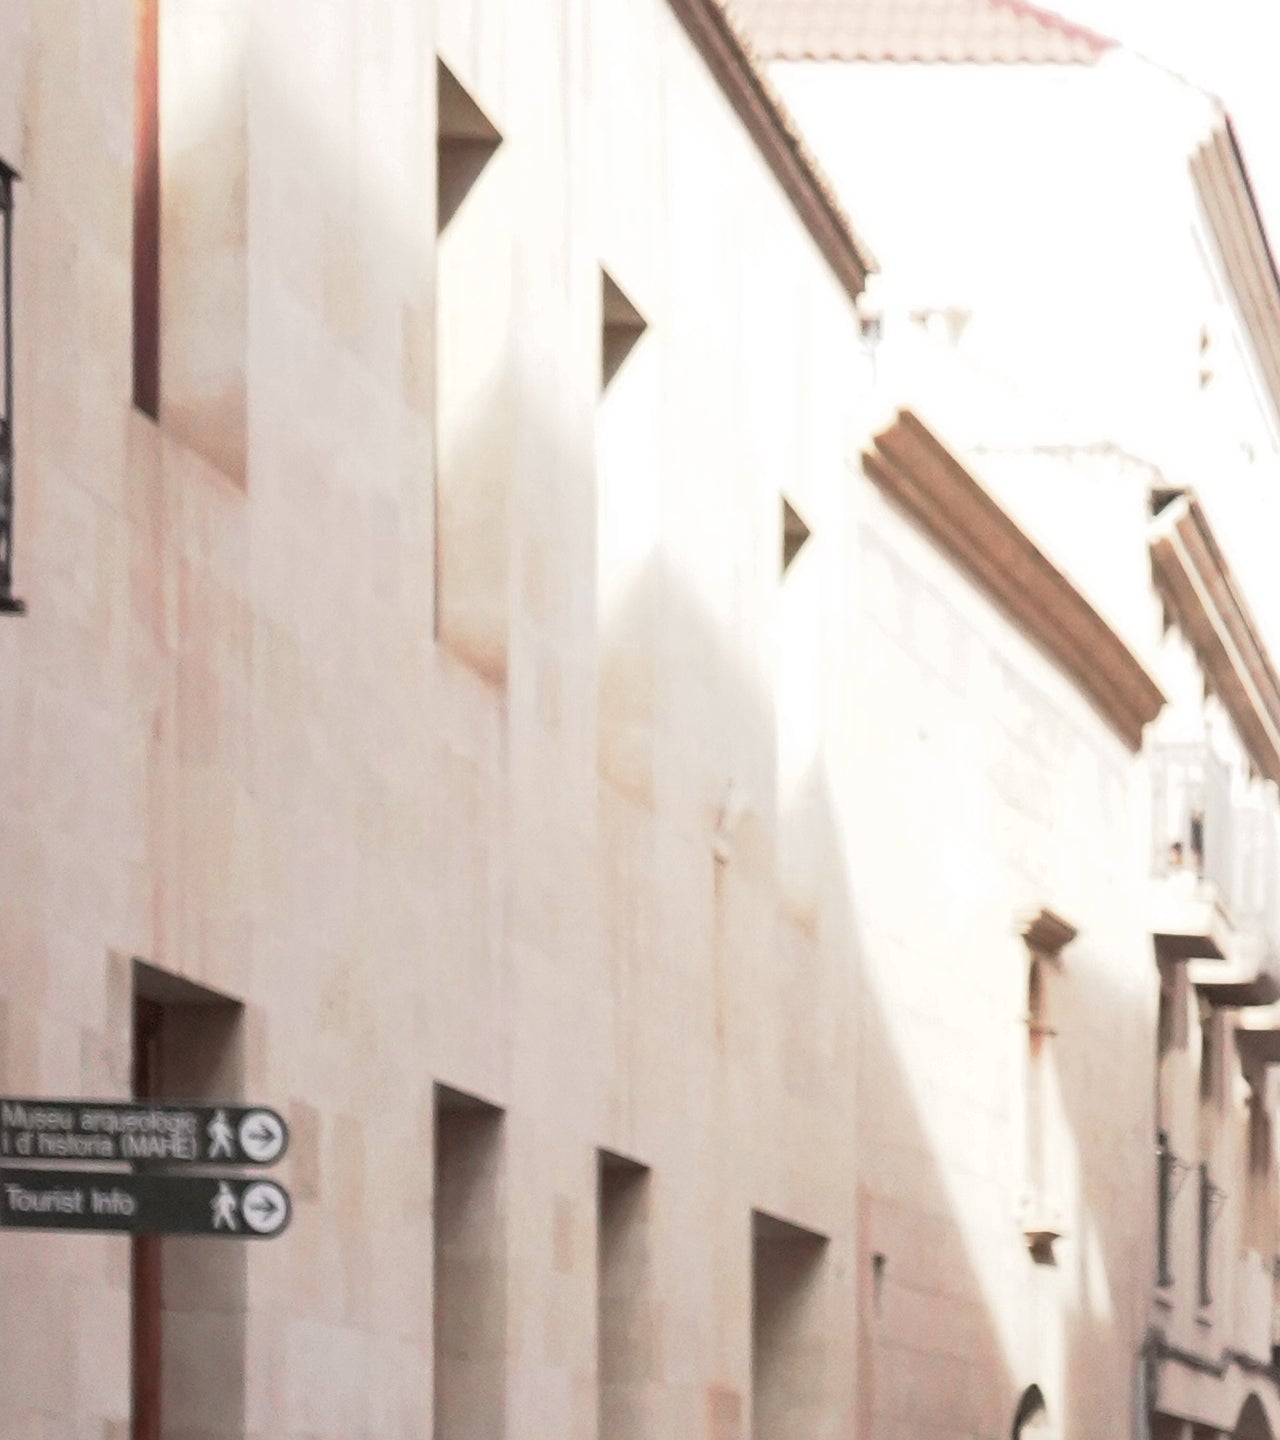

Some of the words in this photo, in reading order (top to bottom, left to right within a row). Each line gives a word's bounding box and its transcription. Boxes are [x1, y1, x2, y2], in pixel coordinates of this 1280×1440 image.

[2, 1103, 73, 1131] Museu
[4, 1183, 83, 1214] Tourist
[90, 1187, 136, 1216] Info
